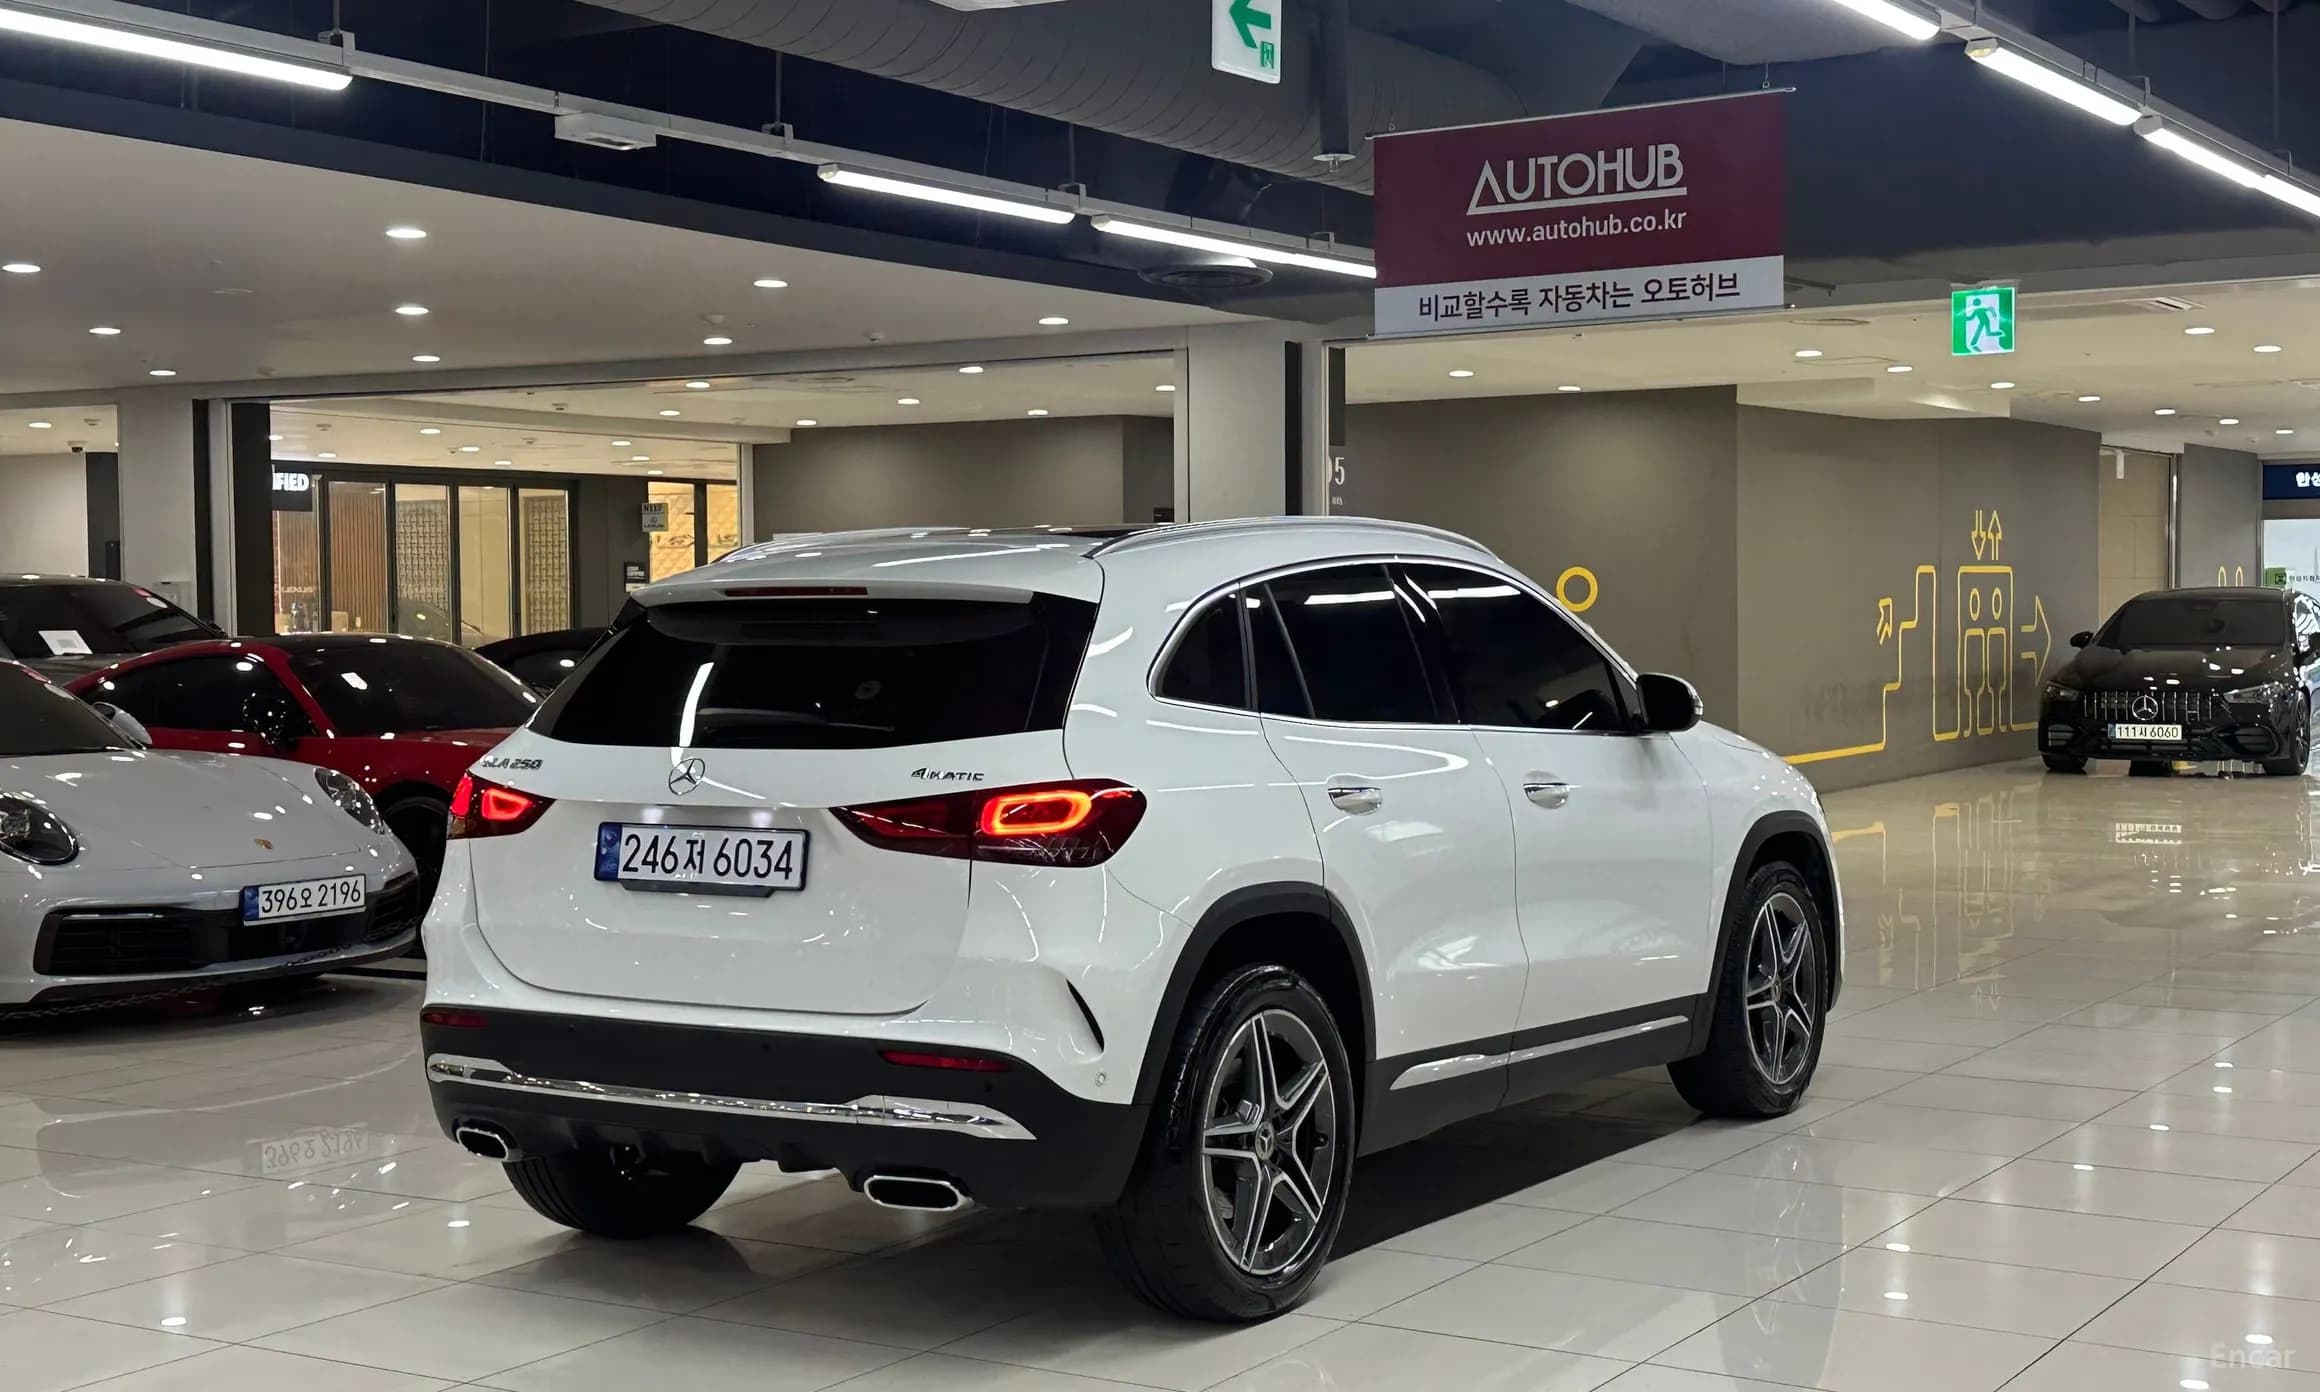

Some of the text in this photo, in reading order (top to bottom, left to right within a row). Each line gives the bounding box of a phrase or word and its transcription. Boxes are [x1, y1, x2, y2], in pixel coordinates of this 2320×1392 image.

[1466, 143, 1687, 215] AUTOHUB
[1466, 208, 1687, 247] www.autohub.co.kr
[1418, 272, 1741, 322] 비교할수록 자동차는 오토허브
[2149, 726, 2179, 738] 6060
[510, 758, 543, 770] 250
[621, 833, 793, 880] 246저 6034
[262, 879, 361, 913] 396오 2196
